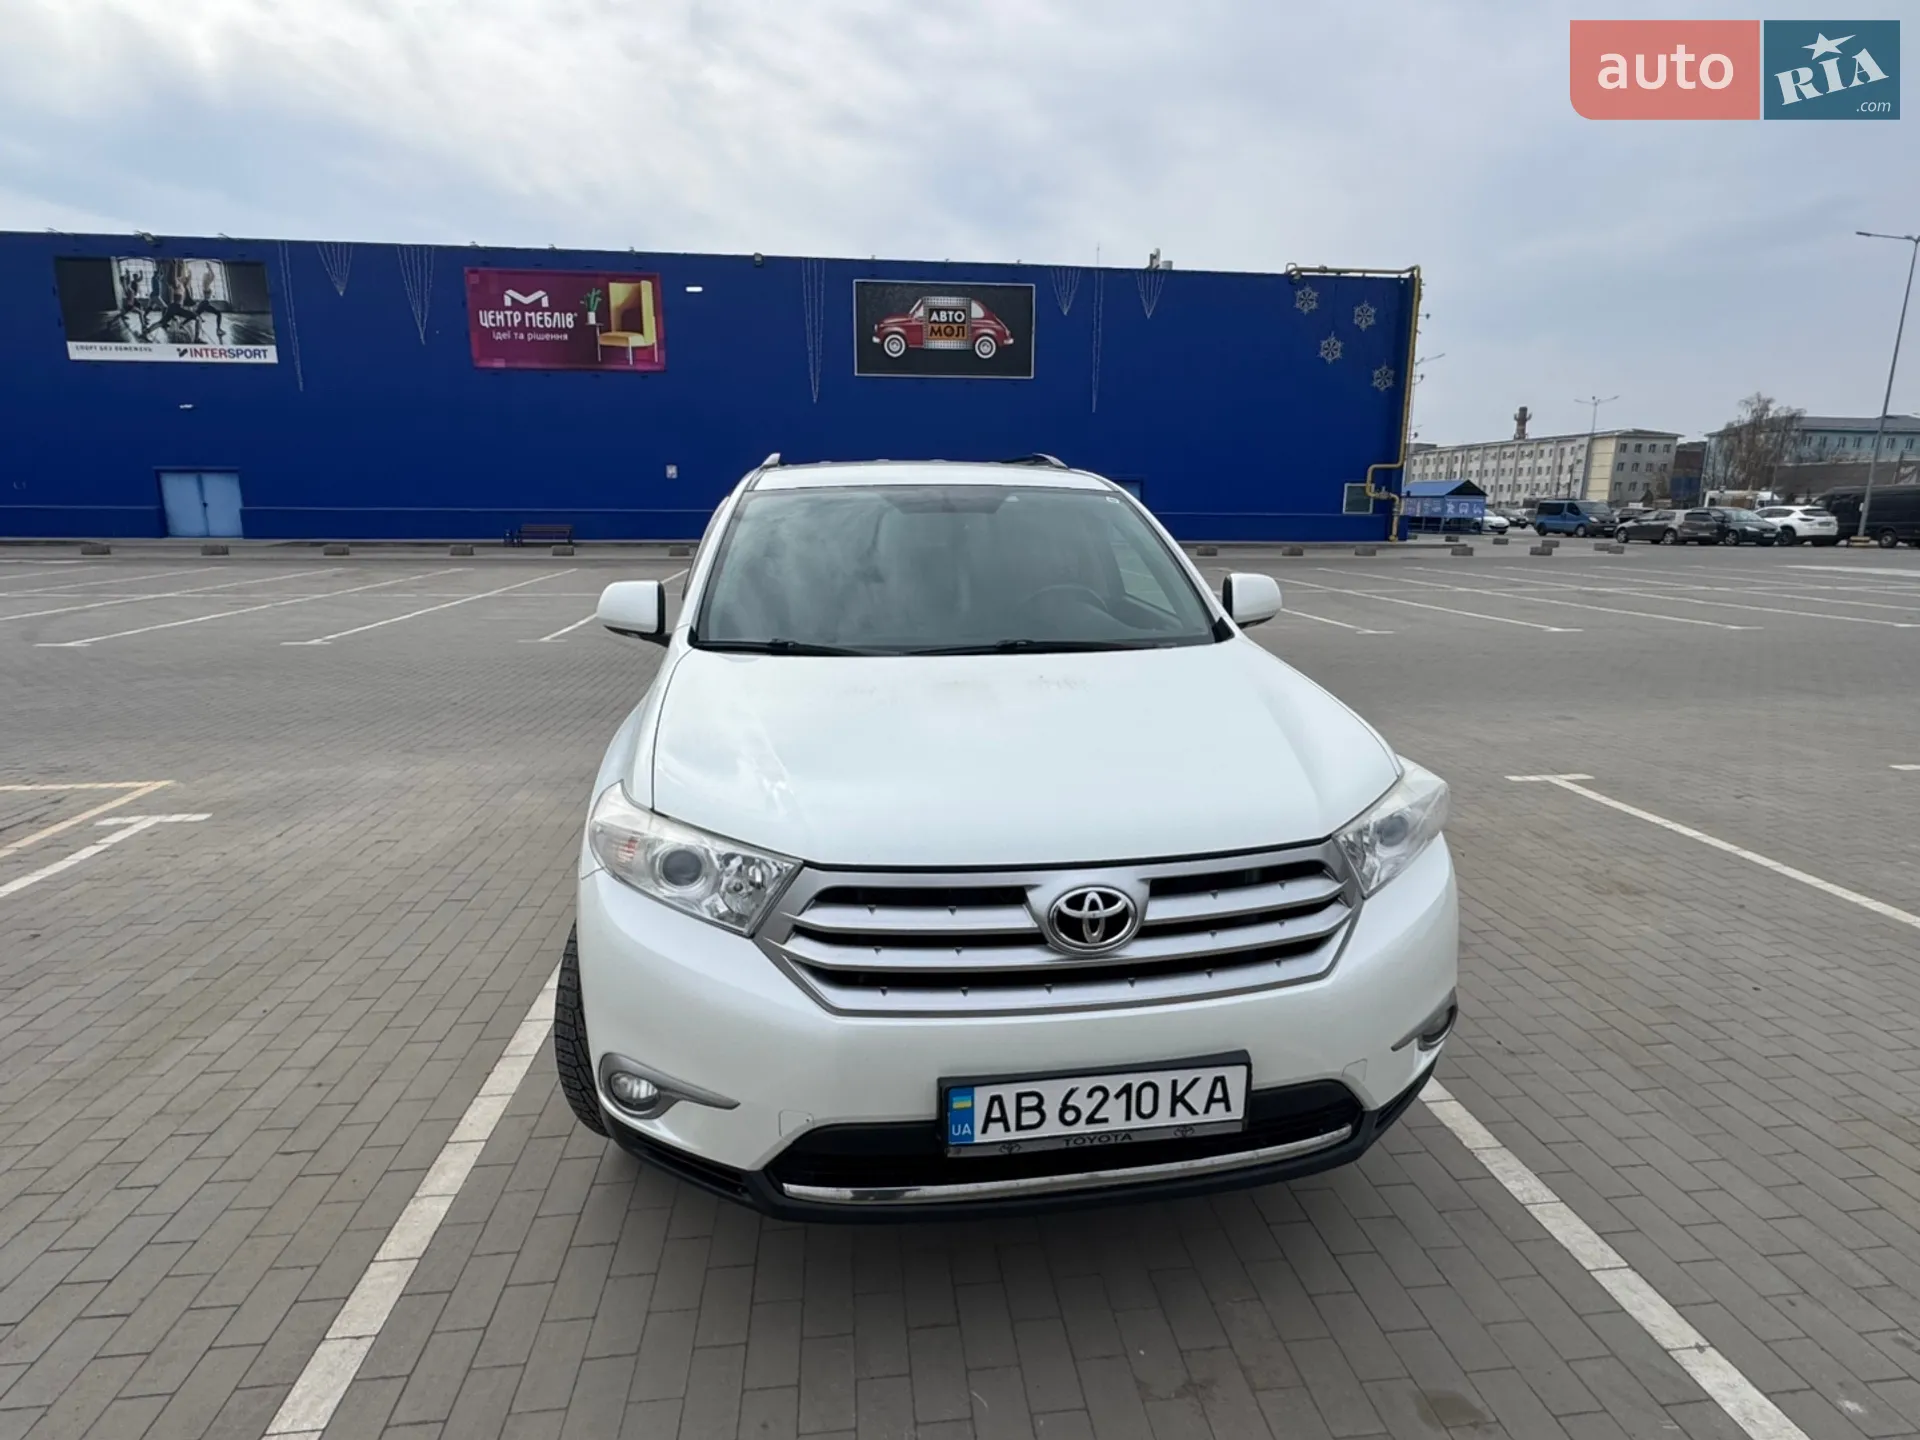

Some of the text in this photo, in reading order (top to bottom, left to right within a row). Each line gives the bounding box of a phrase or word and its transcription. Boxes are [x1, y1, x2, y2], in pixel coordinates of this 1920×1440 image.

[479, 310, 521, 329] ЦЕНТР
[930, 310, 965, 323] АВТО
[492, 331, 568, 341] ідеї та рішення
[929, 325, 966, 338] МОЛ
[189, 347, 268, 359] INTERSPORT
[980, 1075, 1232, 1135] AB 6210 KA
[952, 1123, 972, 1137] UA
[1063, 1132, 1133, 1147] TOYOTA
